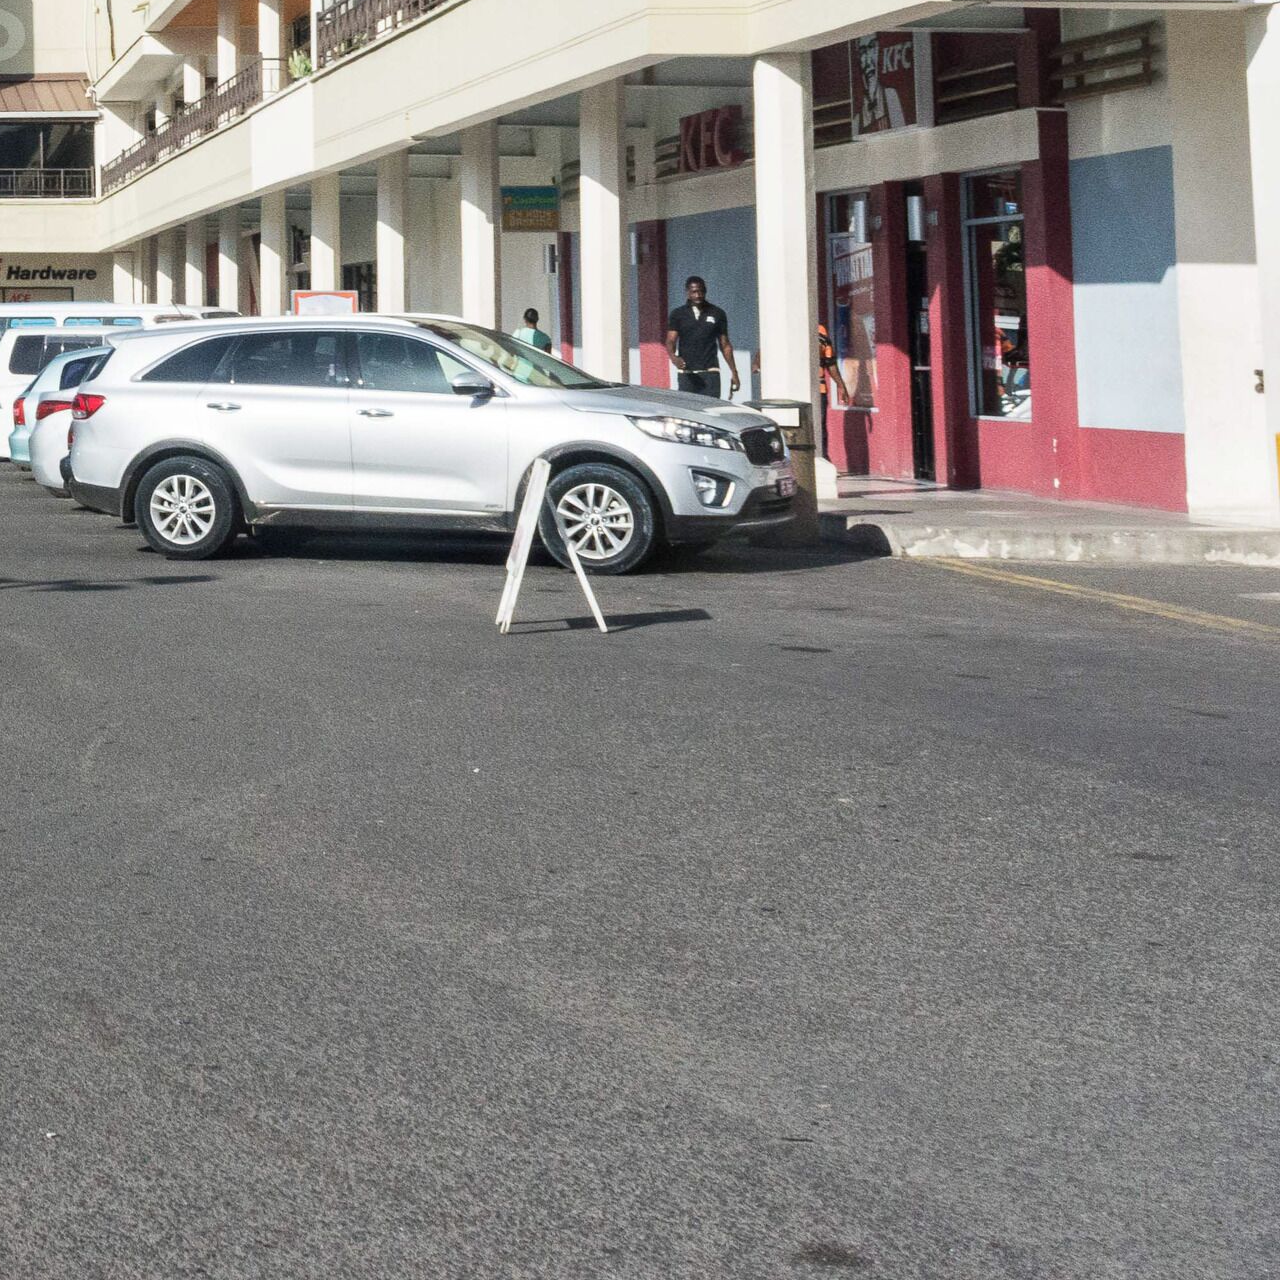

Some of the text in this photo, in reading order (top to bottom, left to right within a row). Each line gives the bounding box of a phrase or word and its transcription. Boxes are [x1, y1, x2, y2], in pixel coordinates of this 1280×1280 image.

[882, 41, 913, 74] KFC
[679, 107, 734, 173] KFC
[6, 265, 98, 281] Hardware
[9, 293, 32, 303] ACE
